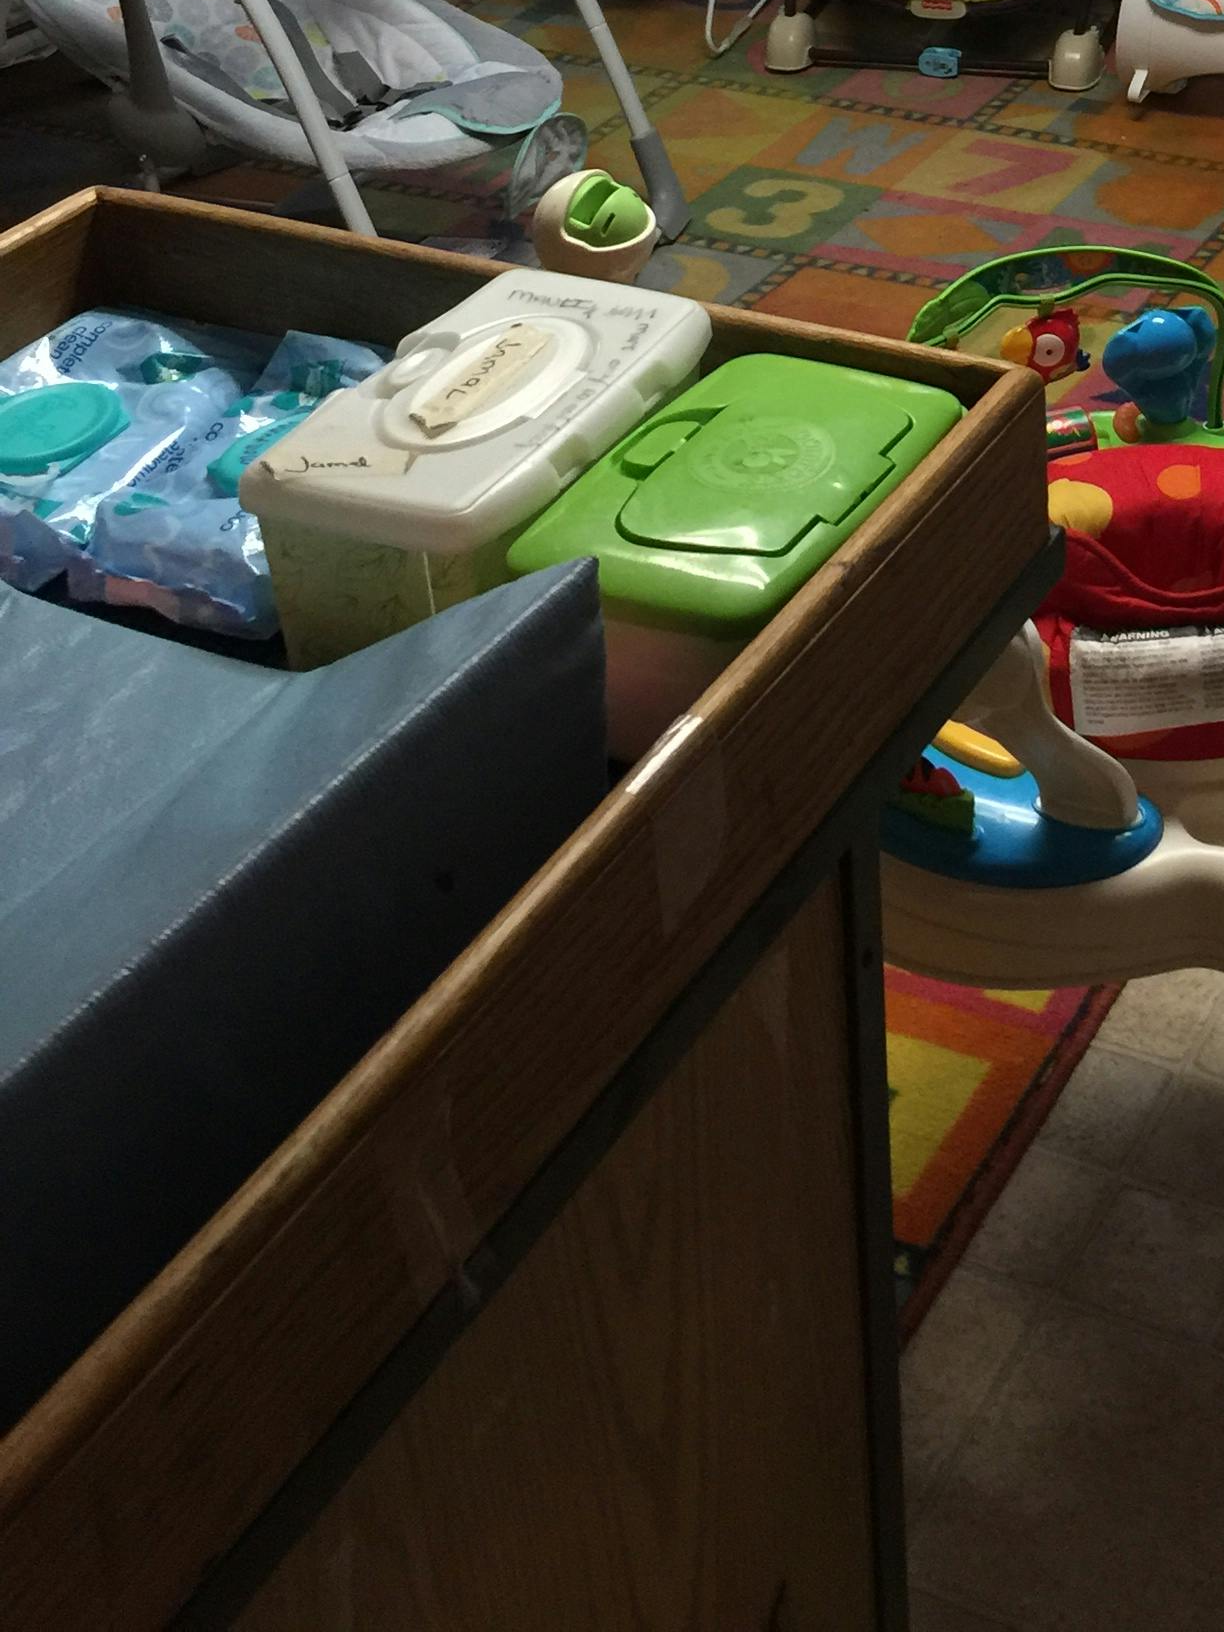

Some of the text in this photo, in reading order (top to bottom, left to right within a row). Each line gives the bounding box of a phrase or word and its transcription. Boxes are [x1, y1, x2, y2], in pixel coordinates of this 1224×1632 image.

[706, 177, 846, 240] 3
[50, 326, 88, 367] clean
[57, 319, 113, 375] complet
